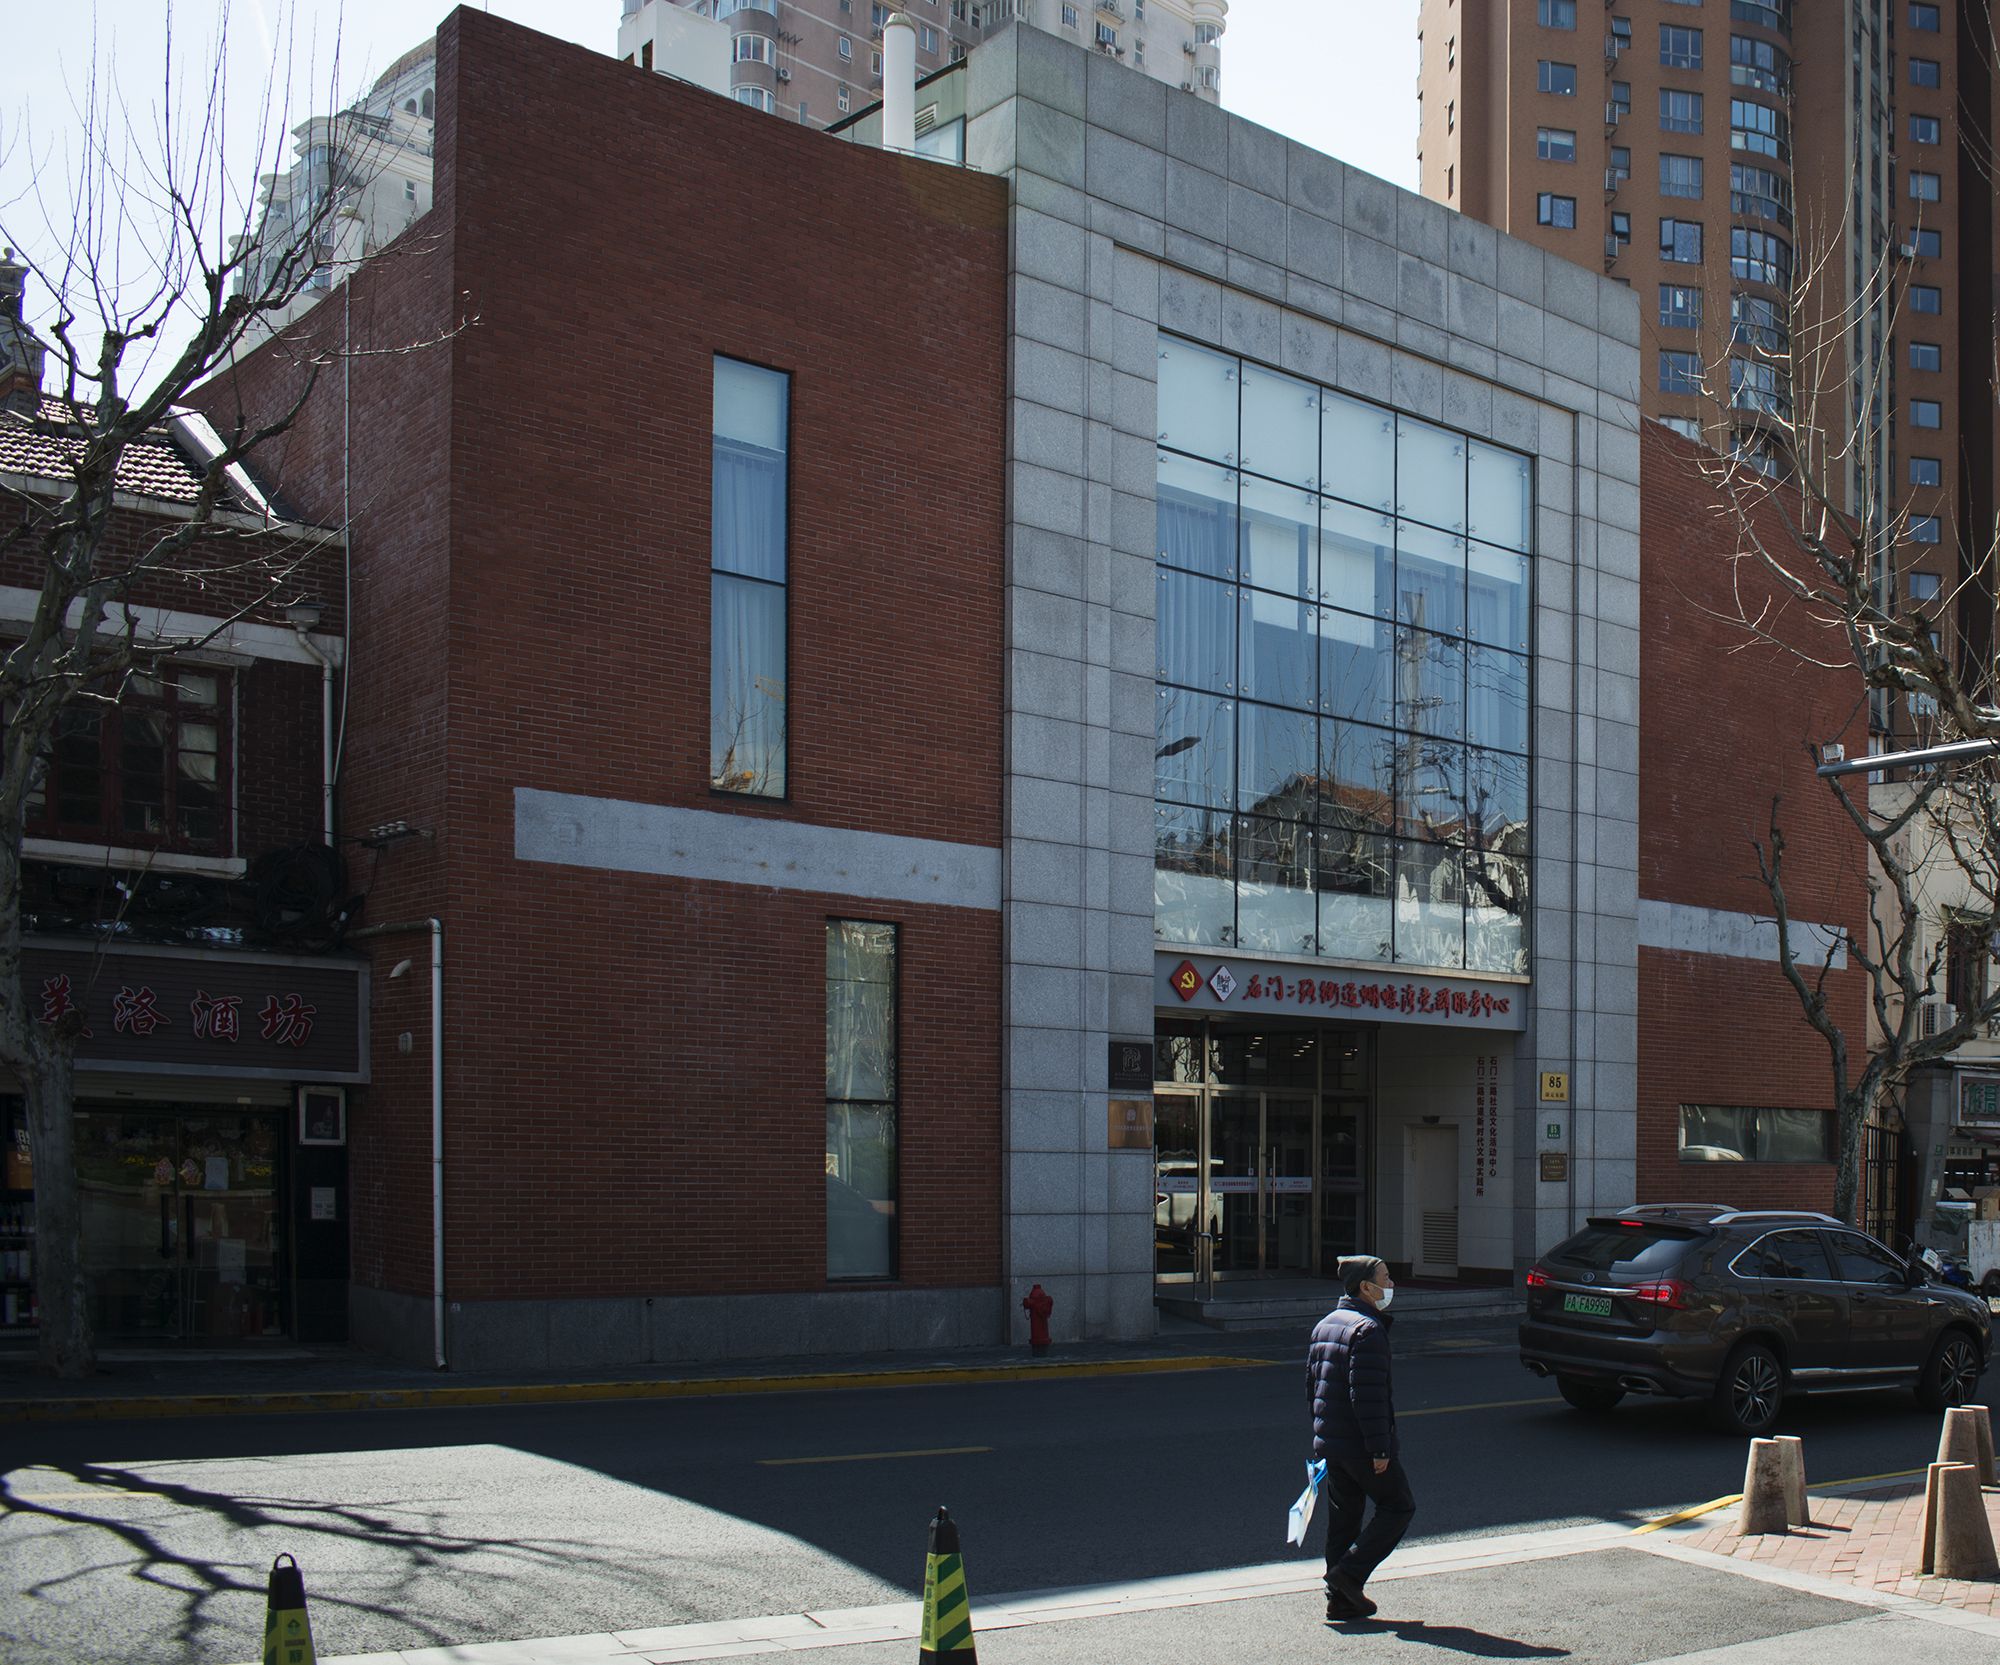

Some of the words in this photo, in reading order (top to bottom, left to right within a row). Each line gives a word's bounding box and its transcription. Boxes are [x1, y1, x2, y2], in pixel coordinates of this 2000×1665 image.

[1549, 1076, 1562, 1089] 85
[1488, 1056, 1498, 1177] 石门二路社区文化活动中心
